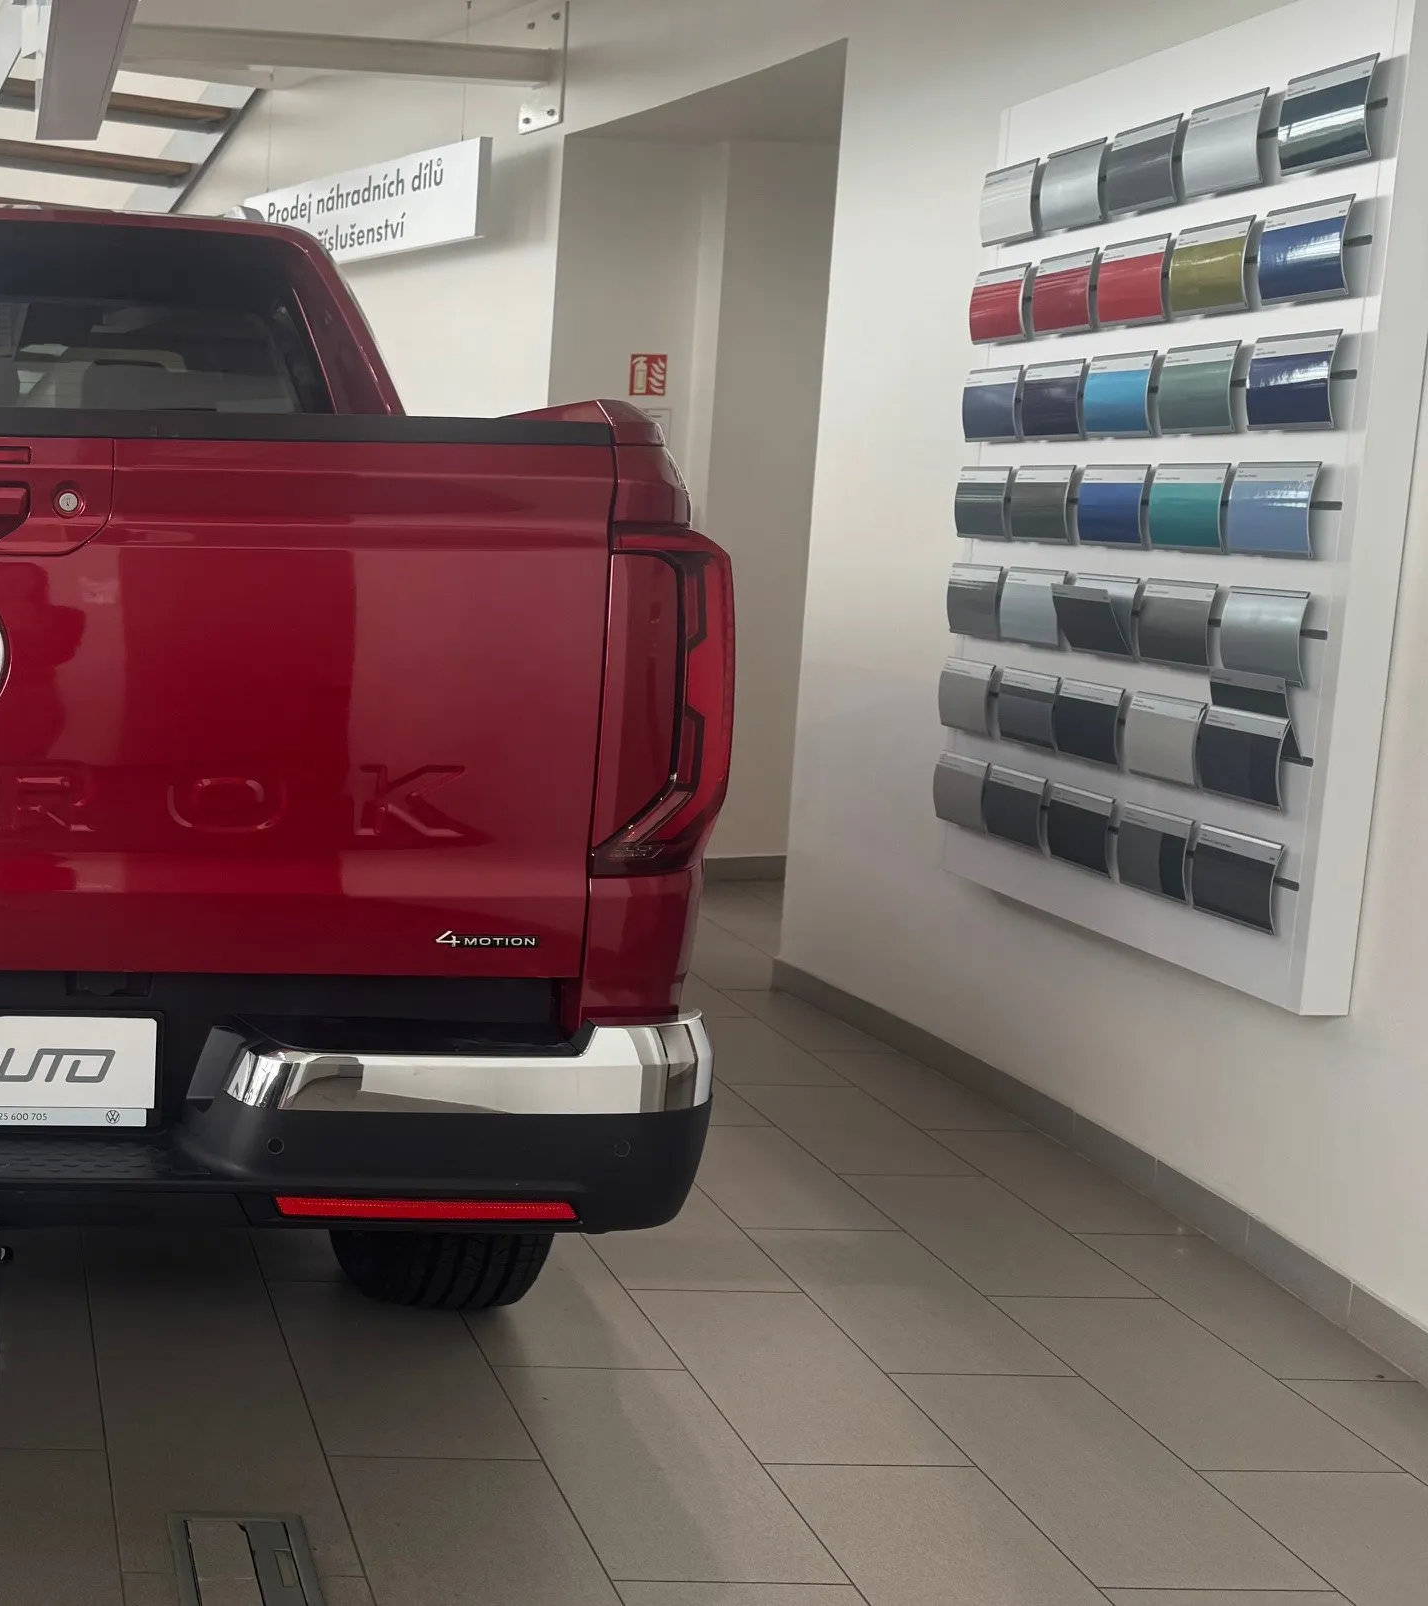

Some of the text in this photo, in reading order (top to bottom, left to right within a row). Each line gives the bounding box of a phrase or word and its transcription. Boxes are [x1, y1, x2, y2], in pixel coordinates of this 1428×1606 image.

[267, 157, 444, 223] Prodej náhradních dílů
[435, 930, 537, 947] 4MOTION
[11, 1112, 29, 1121] 600
[31, 1112, 48, 1121] 705
